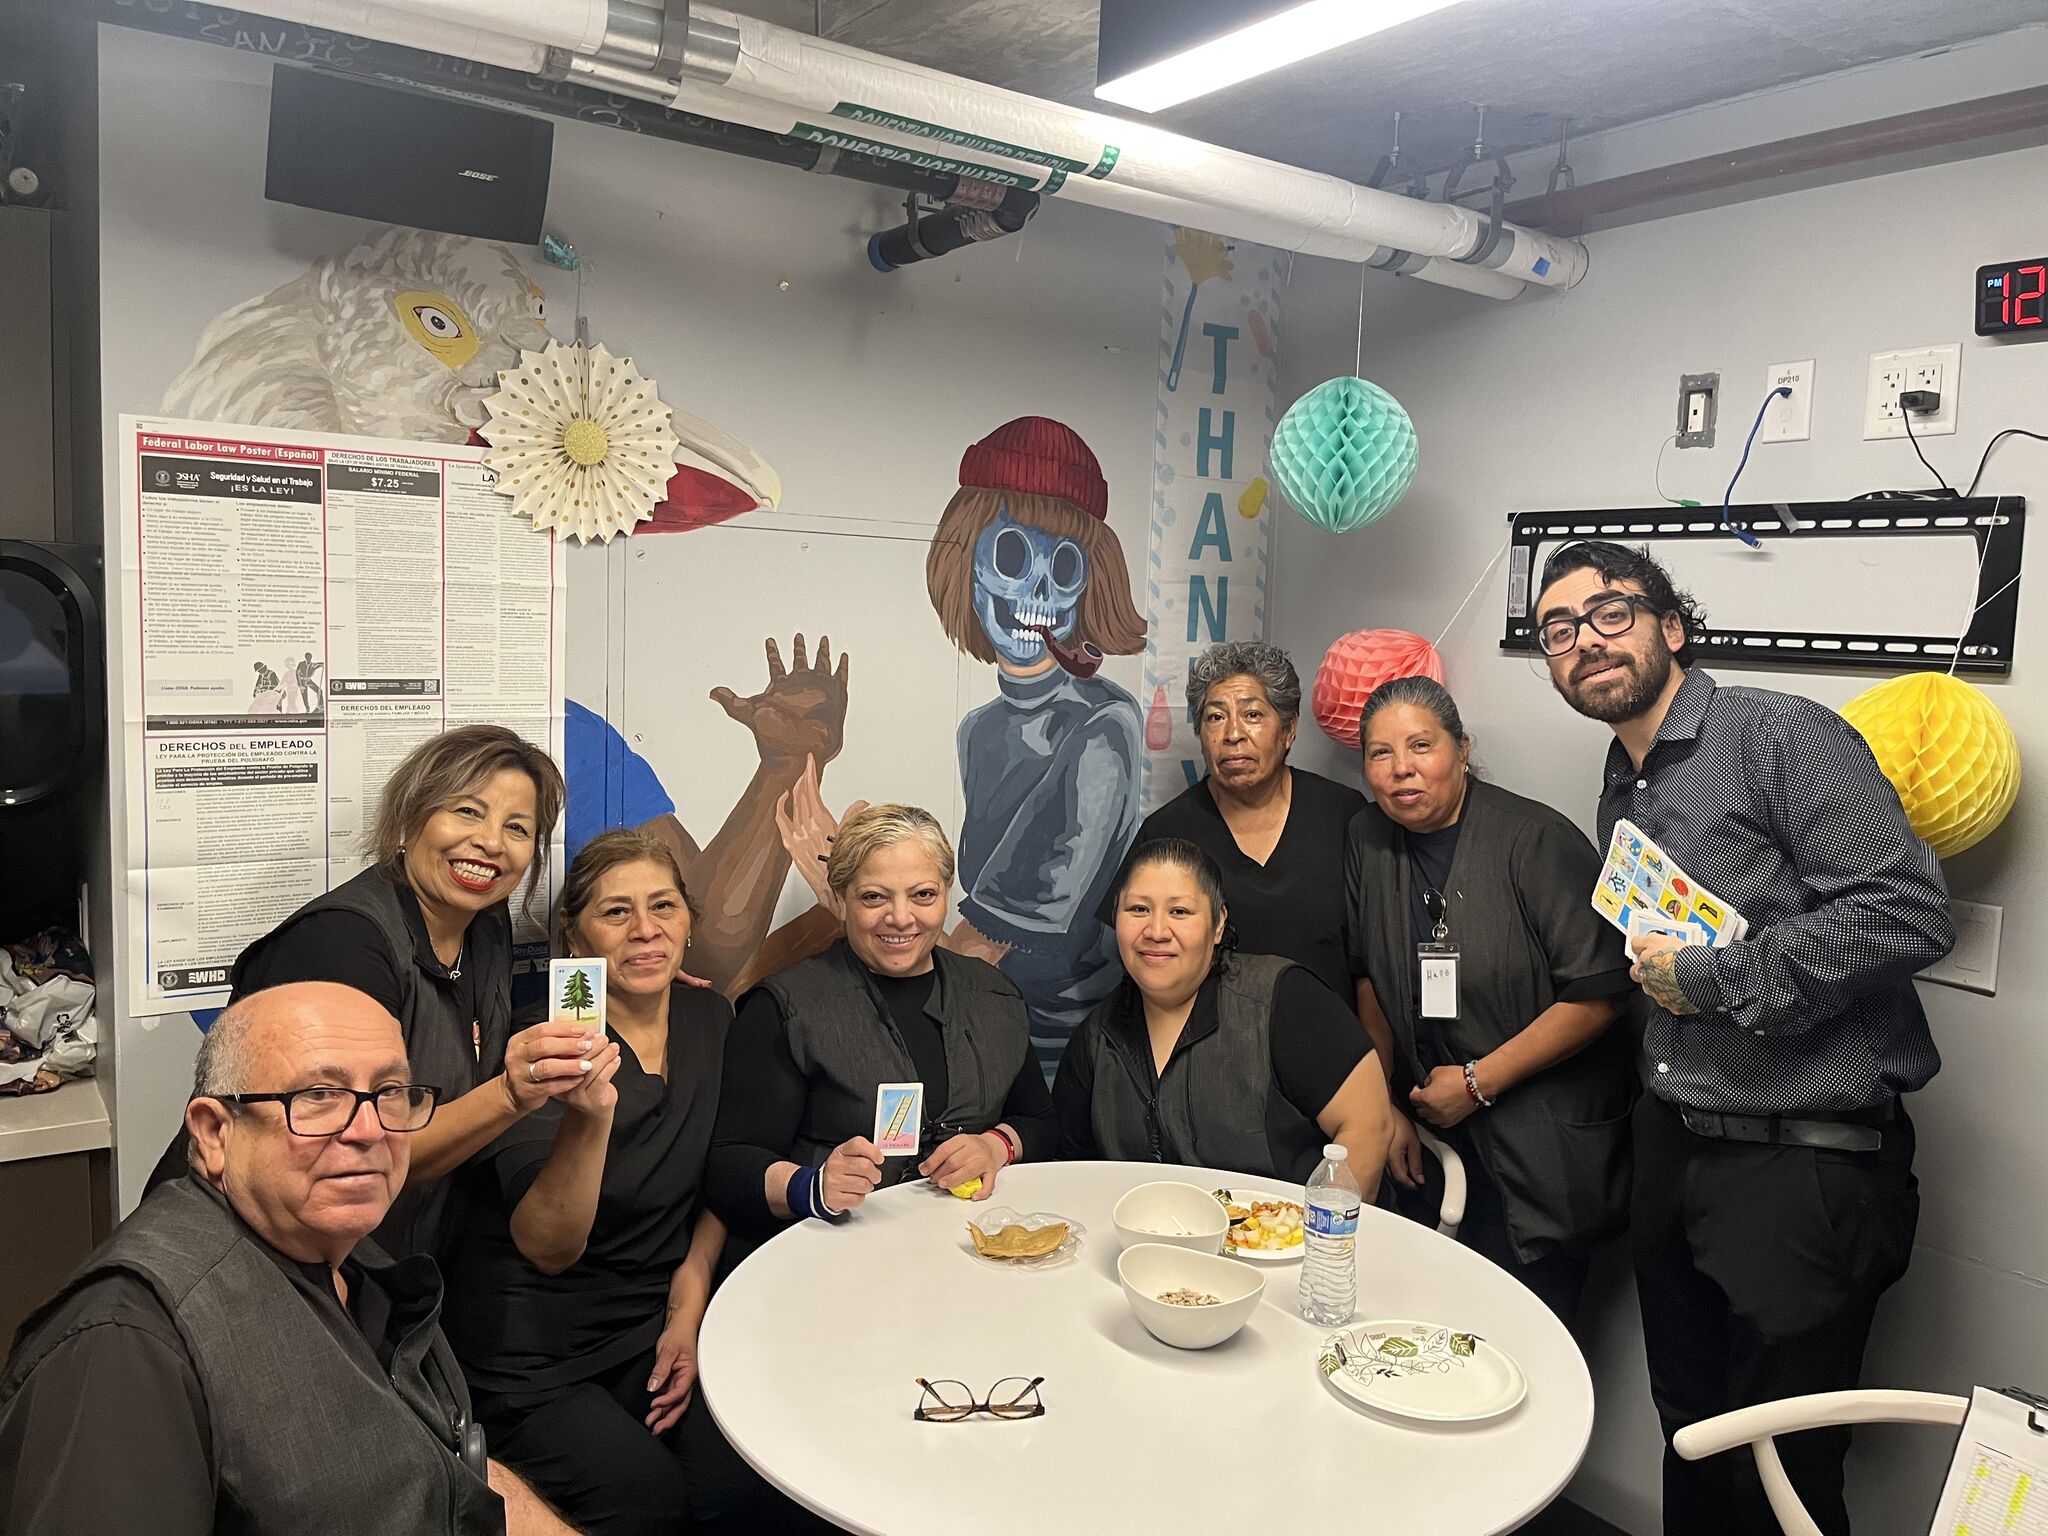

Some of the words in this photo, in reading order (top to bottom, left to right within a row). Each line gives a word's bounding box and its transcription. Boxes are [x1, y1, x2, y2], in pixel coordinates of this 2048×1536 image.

[458, 170, 499, 182] BOSE
[1987, 278, 2002, 288] PM
[2002, 265, 2046, 325] 12
[1777, 375, 1800, 384] DP210
[143, 437, 181, 449] Federal
[185, 440, 213, 451] Labor
[218, 443, 237, 453] Law
[240, 445, 271, 456] Poster
[275, 447, 318, 462] (Español)
[332, 453, 364, 461] DERECHOS
[390, 457, 435, 467] TRABAJADORES
[210, 471, 245, 482] Seguridad
[252, 474, 271, 484] Salud
[282, 477, 288, 485] el
[289, 478, 313, 488] Trabajo
[371, 477, 399, 489] $7.25
[482, 474, 495, 482] LA
[231, 484, 249, 492] ¡ES
[270, 487, 294, 495] LEY!
[160, 742, 227, 752] DERECHOS
[250, 740, 313, 749] EMPLEADO
[195, 970, 226, 983] WHD
